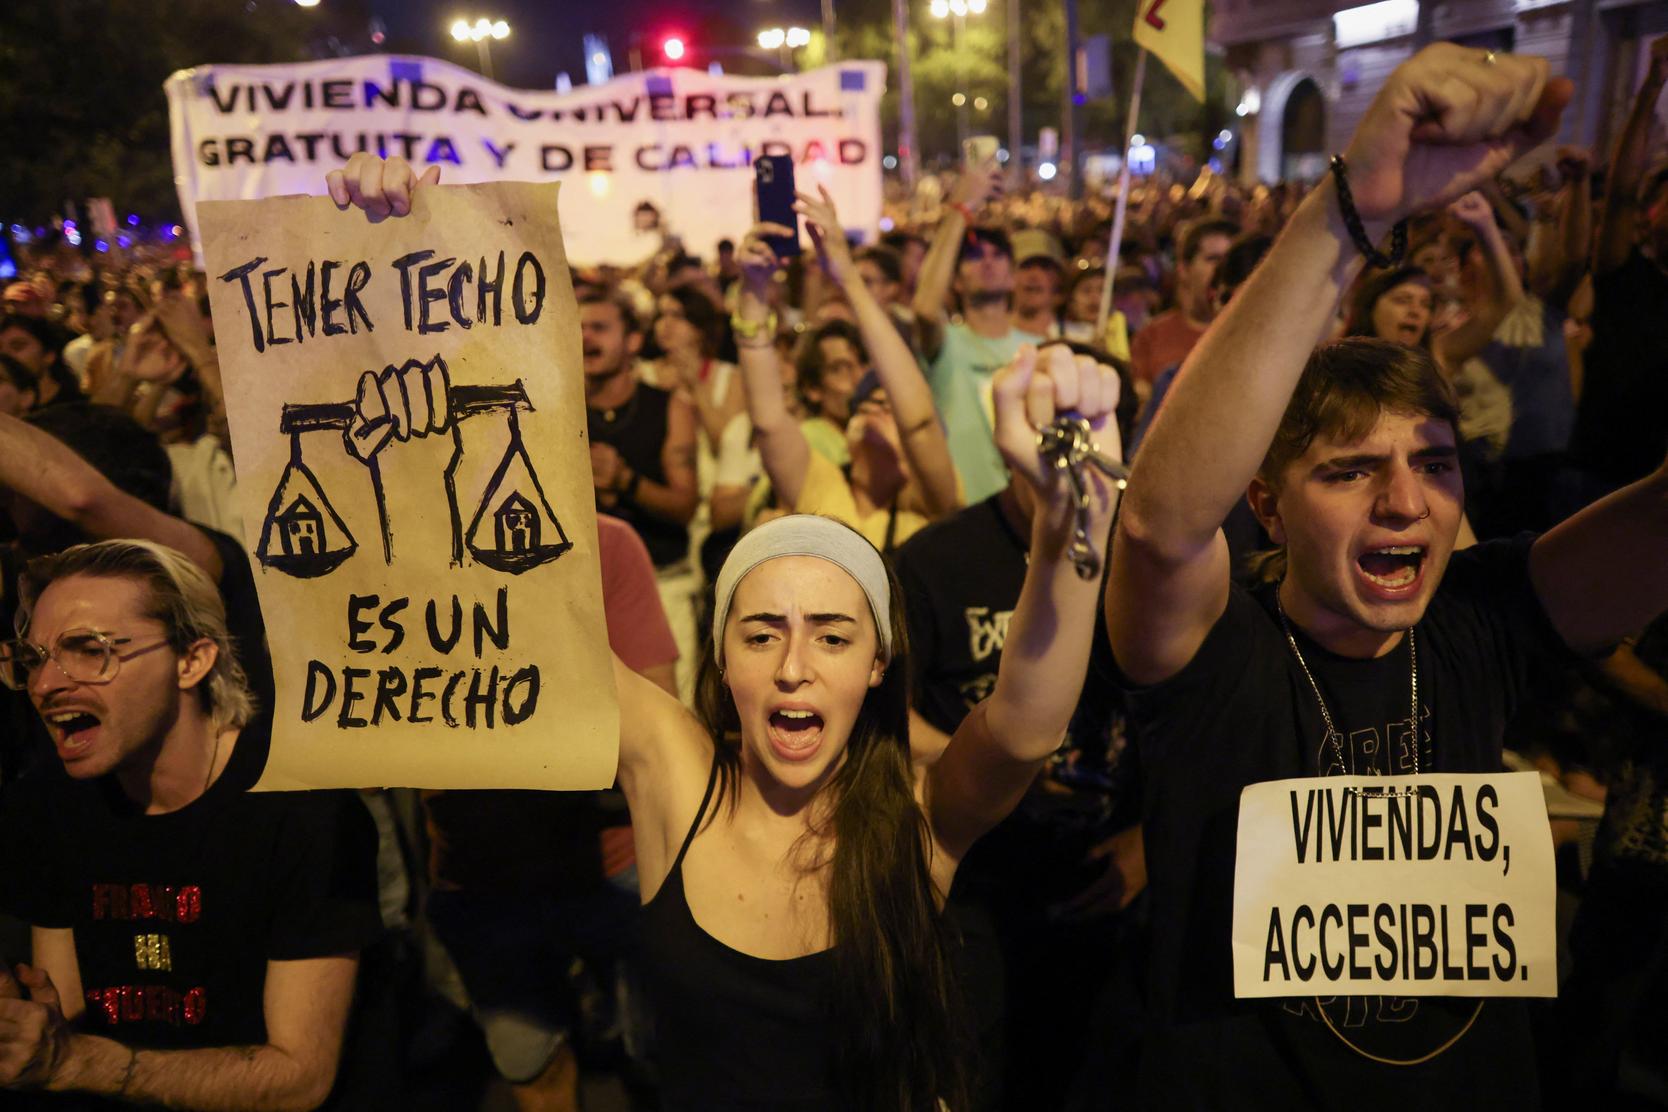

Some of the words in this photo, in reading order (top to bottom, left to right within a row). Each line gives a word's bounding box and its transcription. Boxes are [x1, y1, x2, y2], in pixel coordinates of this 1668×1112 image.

[209, 78, 488, 115] VIVIENDA
[198, 132, 462, 167] GRATUITA
[481, 137, 516, 169] Y
[541, 144, 614, 173] DE
[217, 256, 375, 353] TENER
[392, 249, 546, 335] TECHO
[346, 593, 409, 654] ES
[424, 584, 511, 659] UN
[300, 660, 542, 730] DERECHO
[1289, 783, 1511, 877] VIVIENDAS,
[1262, 902, 1529, 982] ACCESIBLES.
